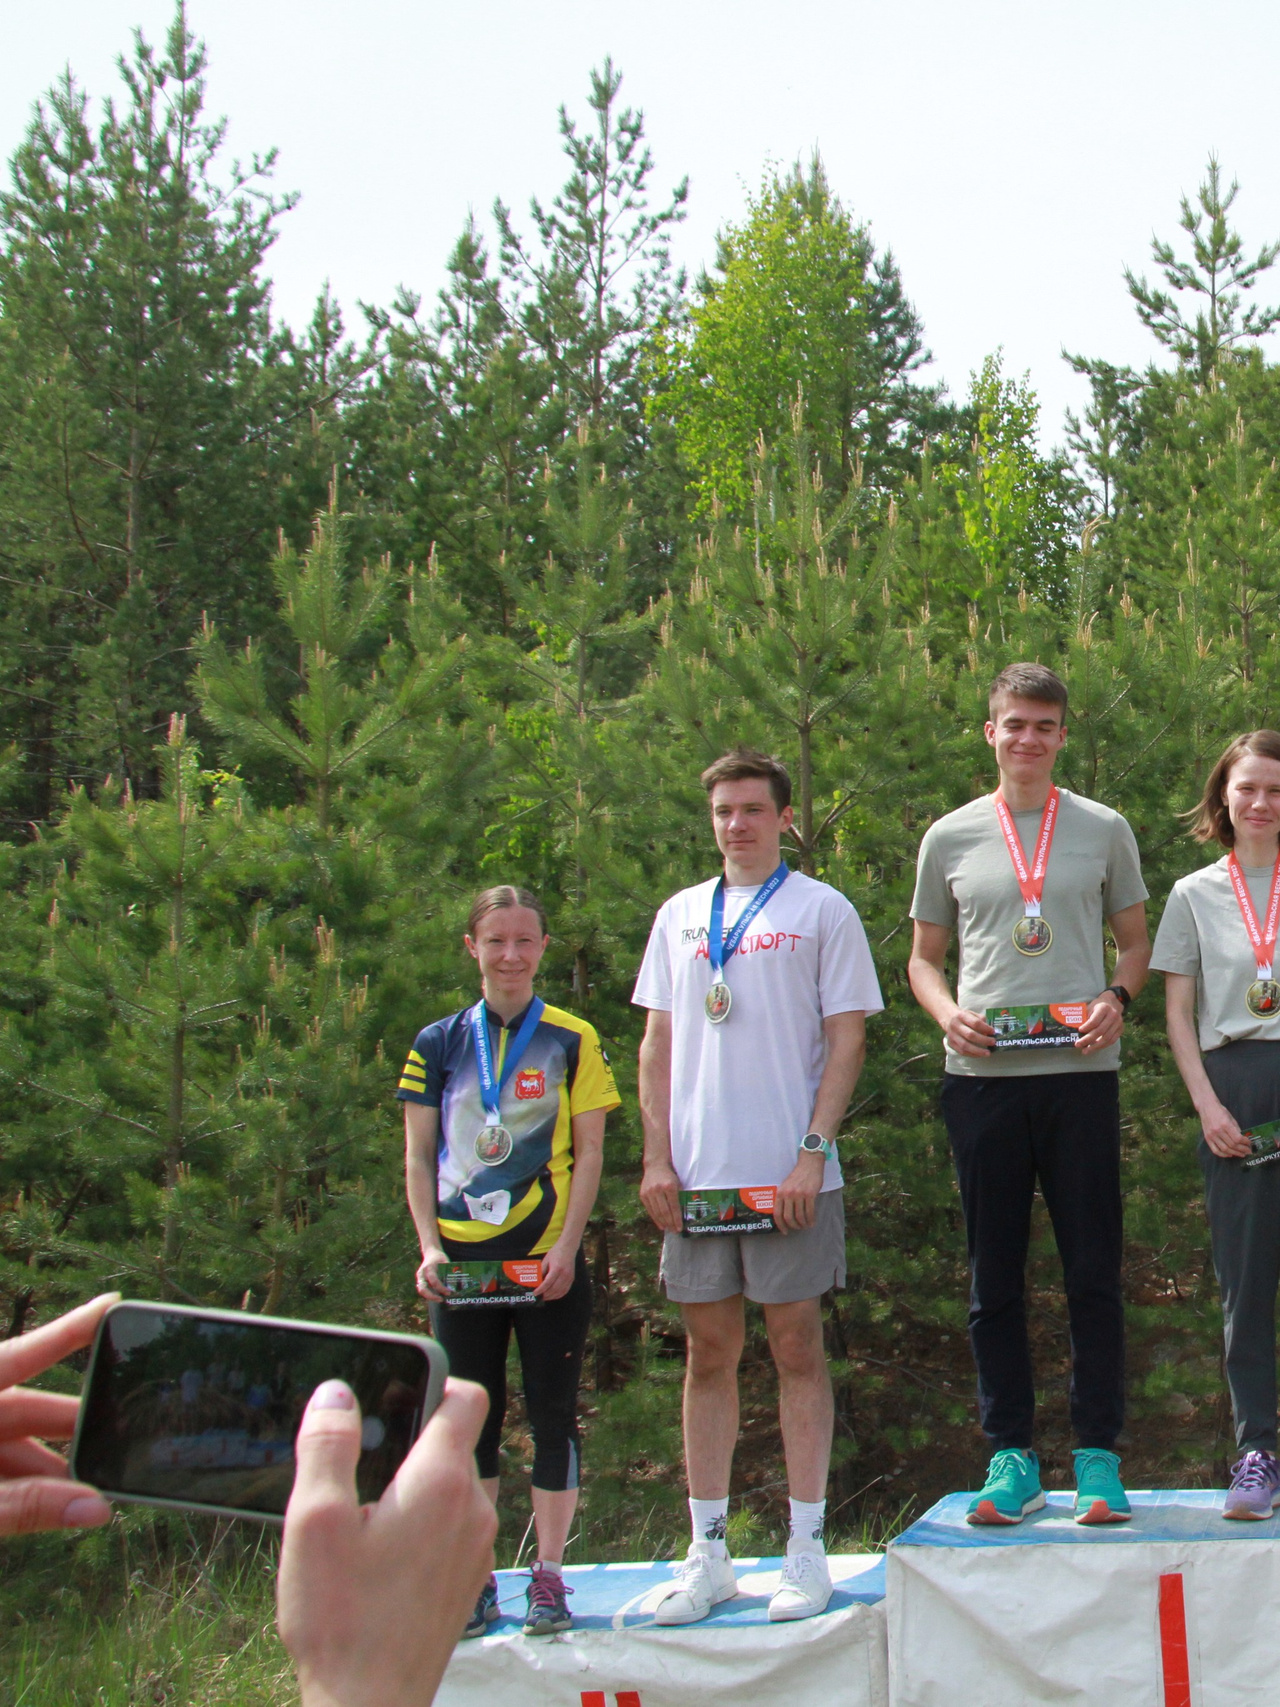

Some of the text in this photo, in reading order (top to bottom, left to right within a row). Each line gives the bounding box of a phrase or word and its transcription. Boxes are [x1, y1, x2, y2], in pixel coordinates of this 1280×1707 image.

[1002, 815, 1012, 834] ВЕСНА
[1008, 834, 1027, 882] ЧЕБАРКУЛЬСКАЯ
[1033, 831, 1049, 880] ЧЕБАРКУЛЬСКАЯ
[1044, 812, 1053, 831] ВЕСНА
[1235, 878, 1245, 897] ВЕСНА
[726, 905, 758, 950] ЧЕБАРКУЛЬСКАЯ
[756, 889, 770, 907] ВЕСНА
[1241, 897, 1261, 946] ЧЕБАРКУЛЬСКАЯ
[1265, 894, 1279, 945] ЧЕБАРКУЛЬСКАЯ
[1055, 1035, 1080, 1043] ВЕСНА
[687, 1222, 772, 1233] ЧЕБАРКУЛЬСКАЯ ВЕСНА
[446, 1295, 536, 1305] ЧЕБАРКУЛЬСКАЯ ВЕСНА
